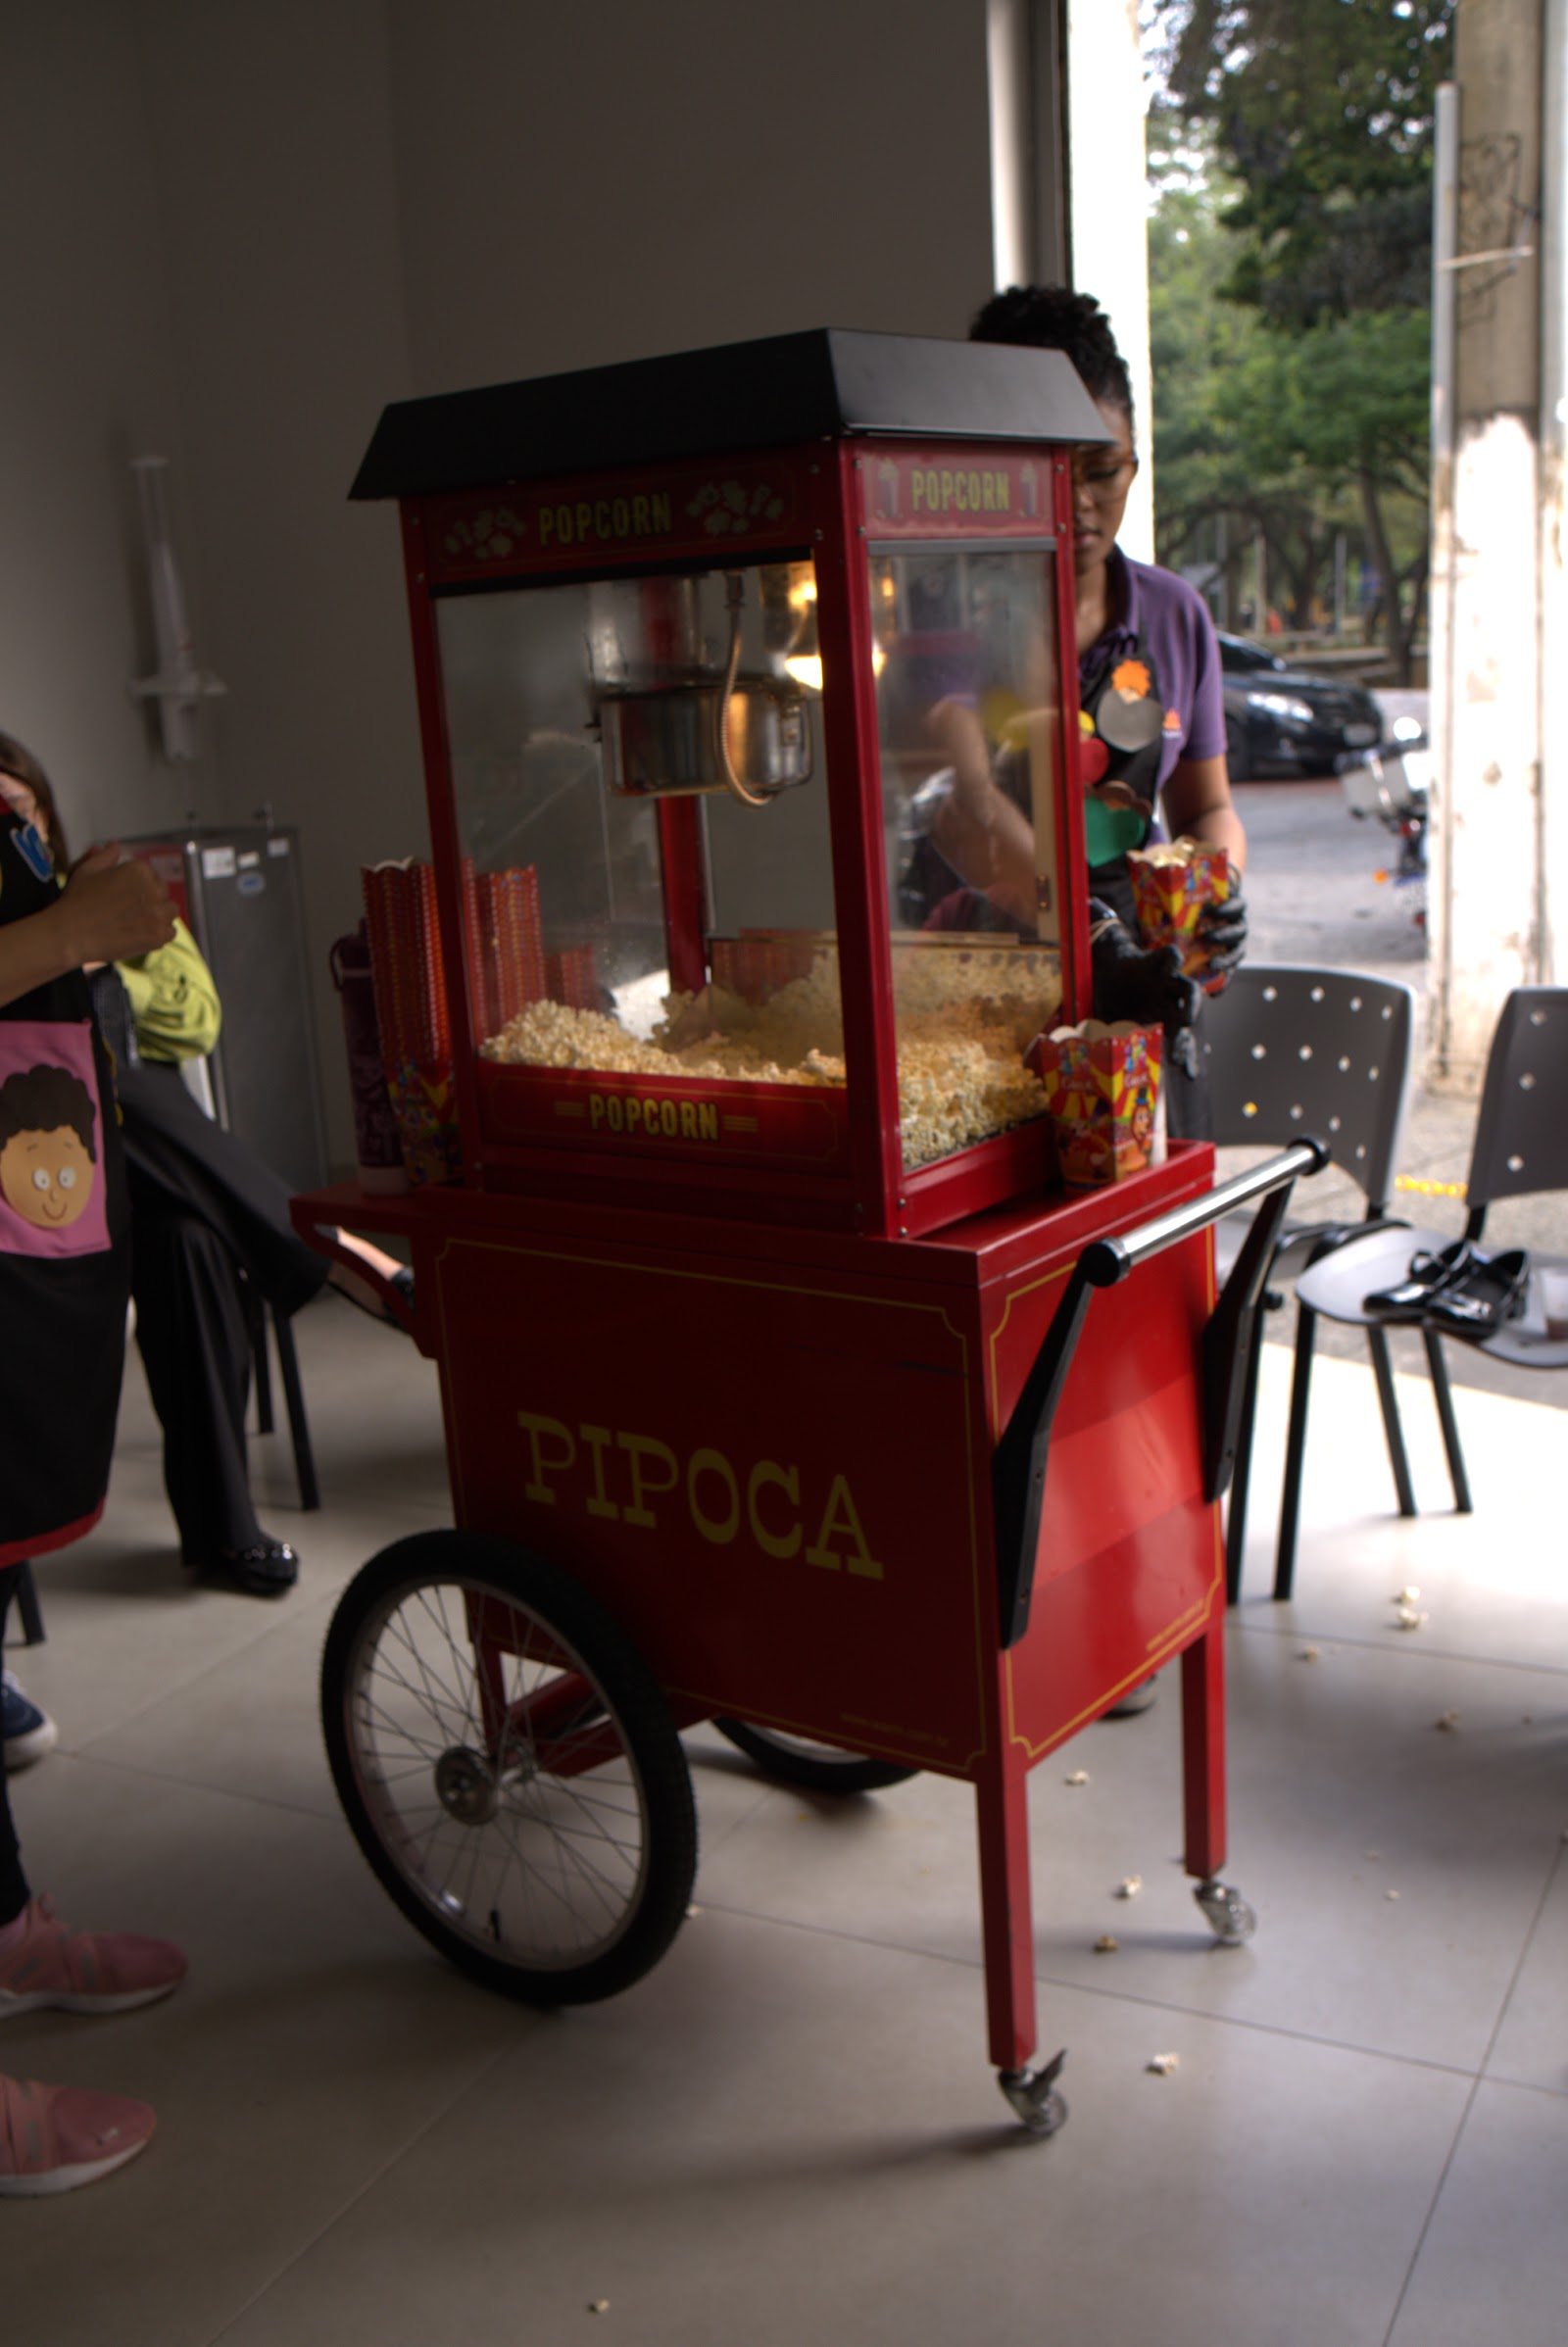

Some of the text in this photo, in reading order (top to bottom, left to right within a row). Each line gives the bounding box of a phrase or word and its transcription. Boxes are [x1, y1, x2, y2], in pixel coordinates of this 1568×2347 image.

[909, 468, 1010, 512] POPCORN
[537, 490, 673, 548] POPCORN
[589, 1092, 719, 1142] POPCORN
[516, 1409, 885, 1582] PIPOCA
